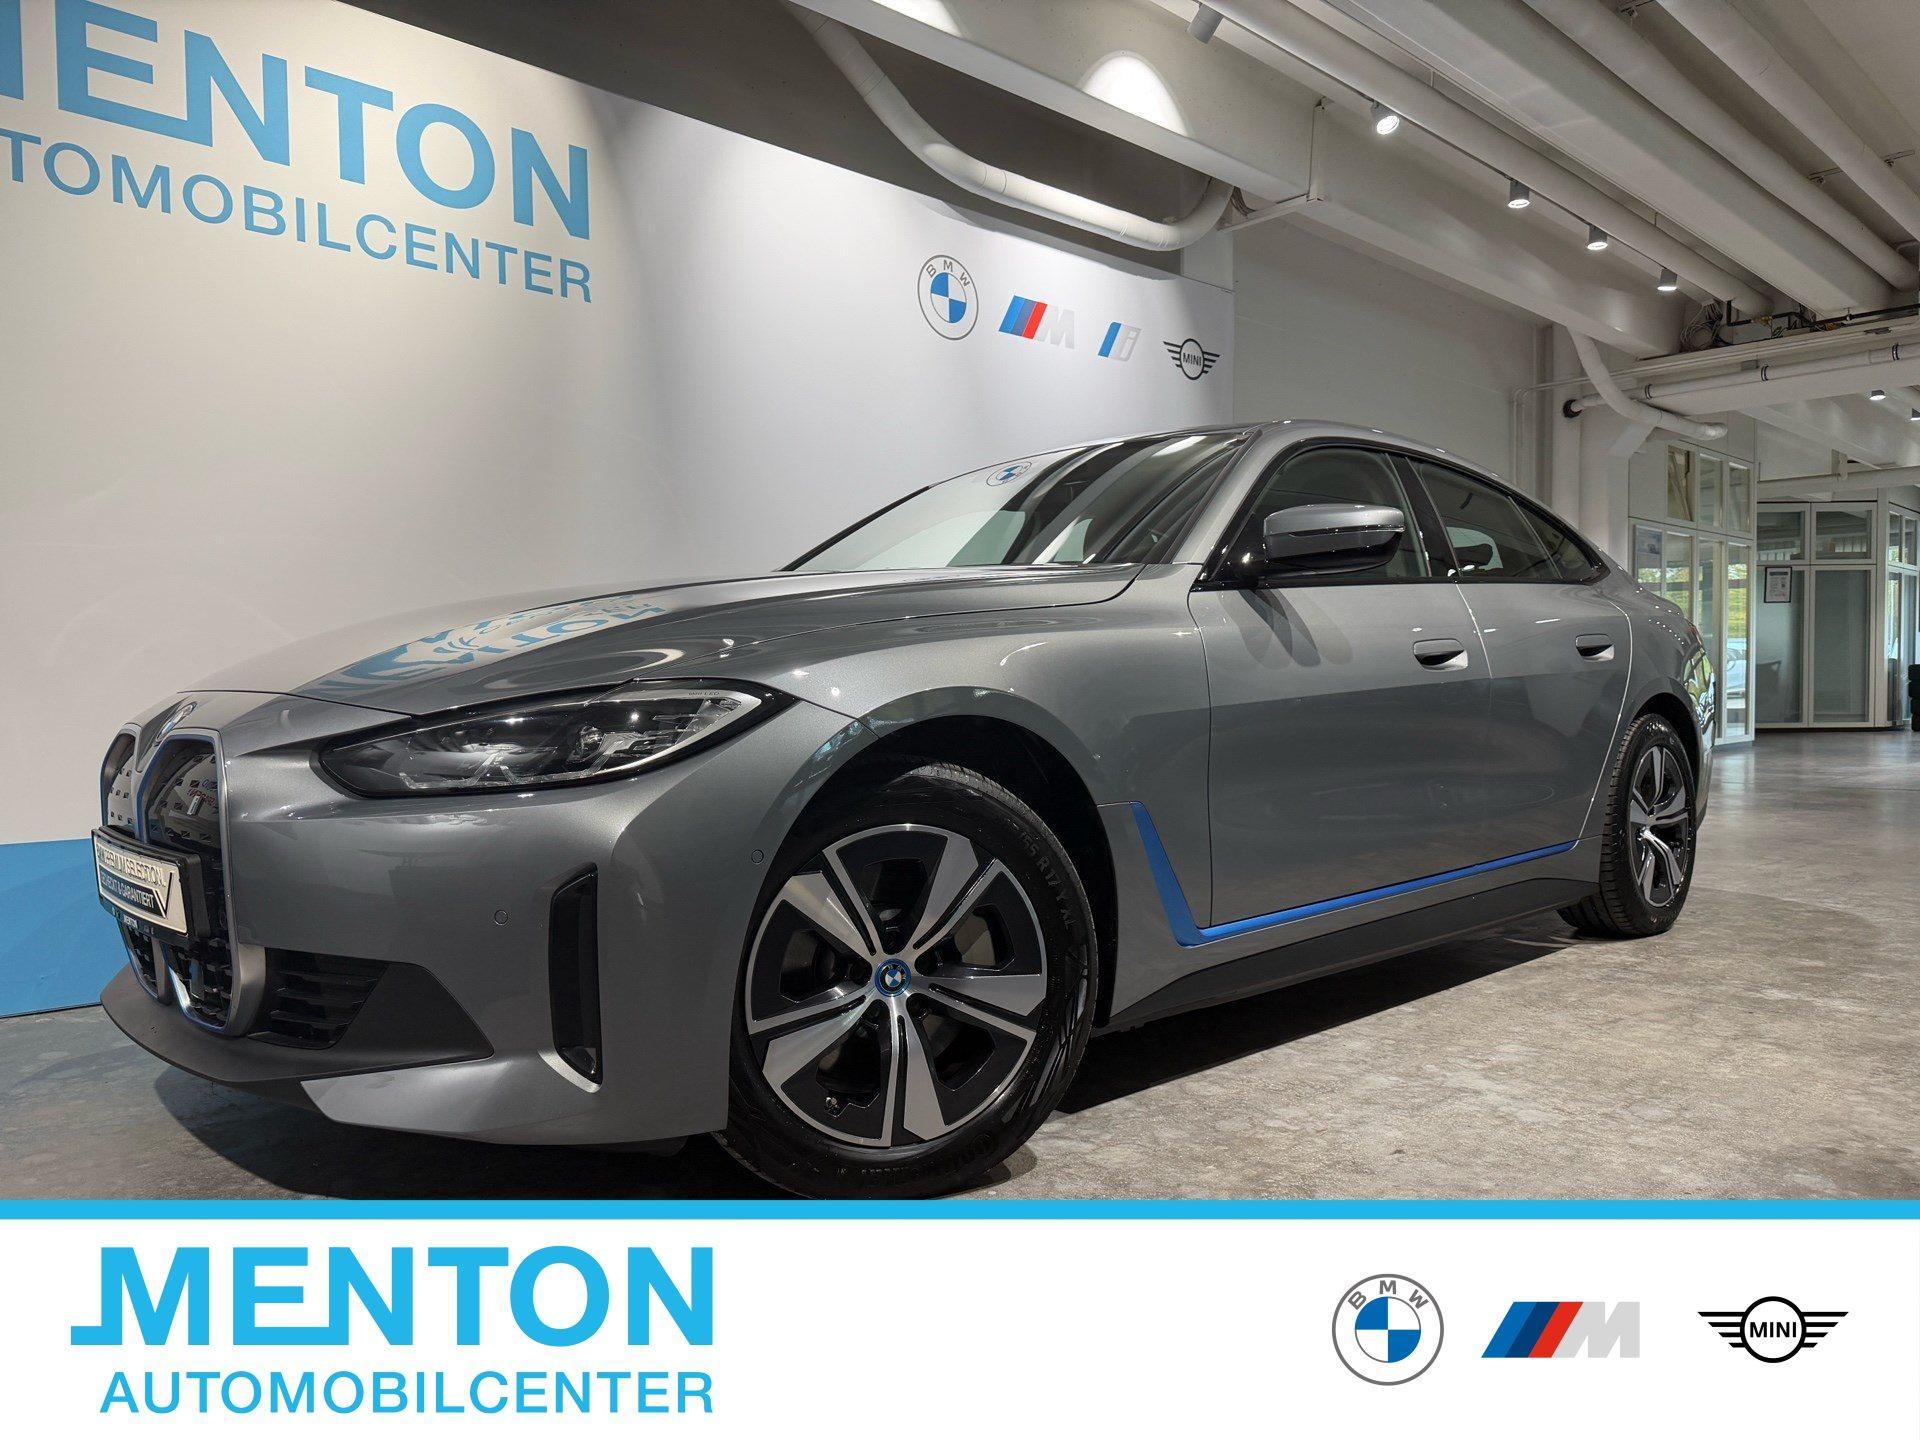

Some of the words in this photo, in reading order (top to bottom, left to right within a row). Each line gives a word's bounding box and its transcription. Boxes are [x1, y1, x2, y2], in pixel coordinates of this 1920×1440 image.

[0, 0, 590, 240] ENTON
[925, 259, 970, 287] BMW
[1182, 352, 1202, 367] MINI
